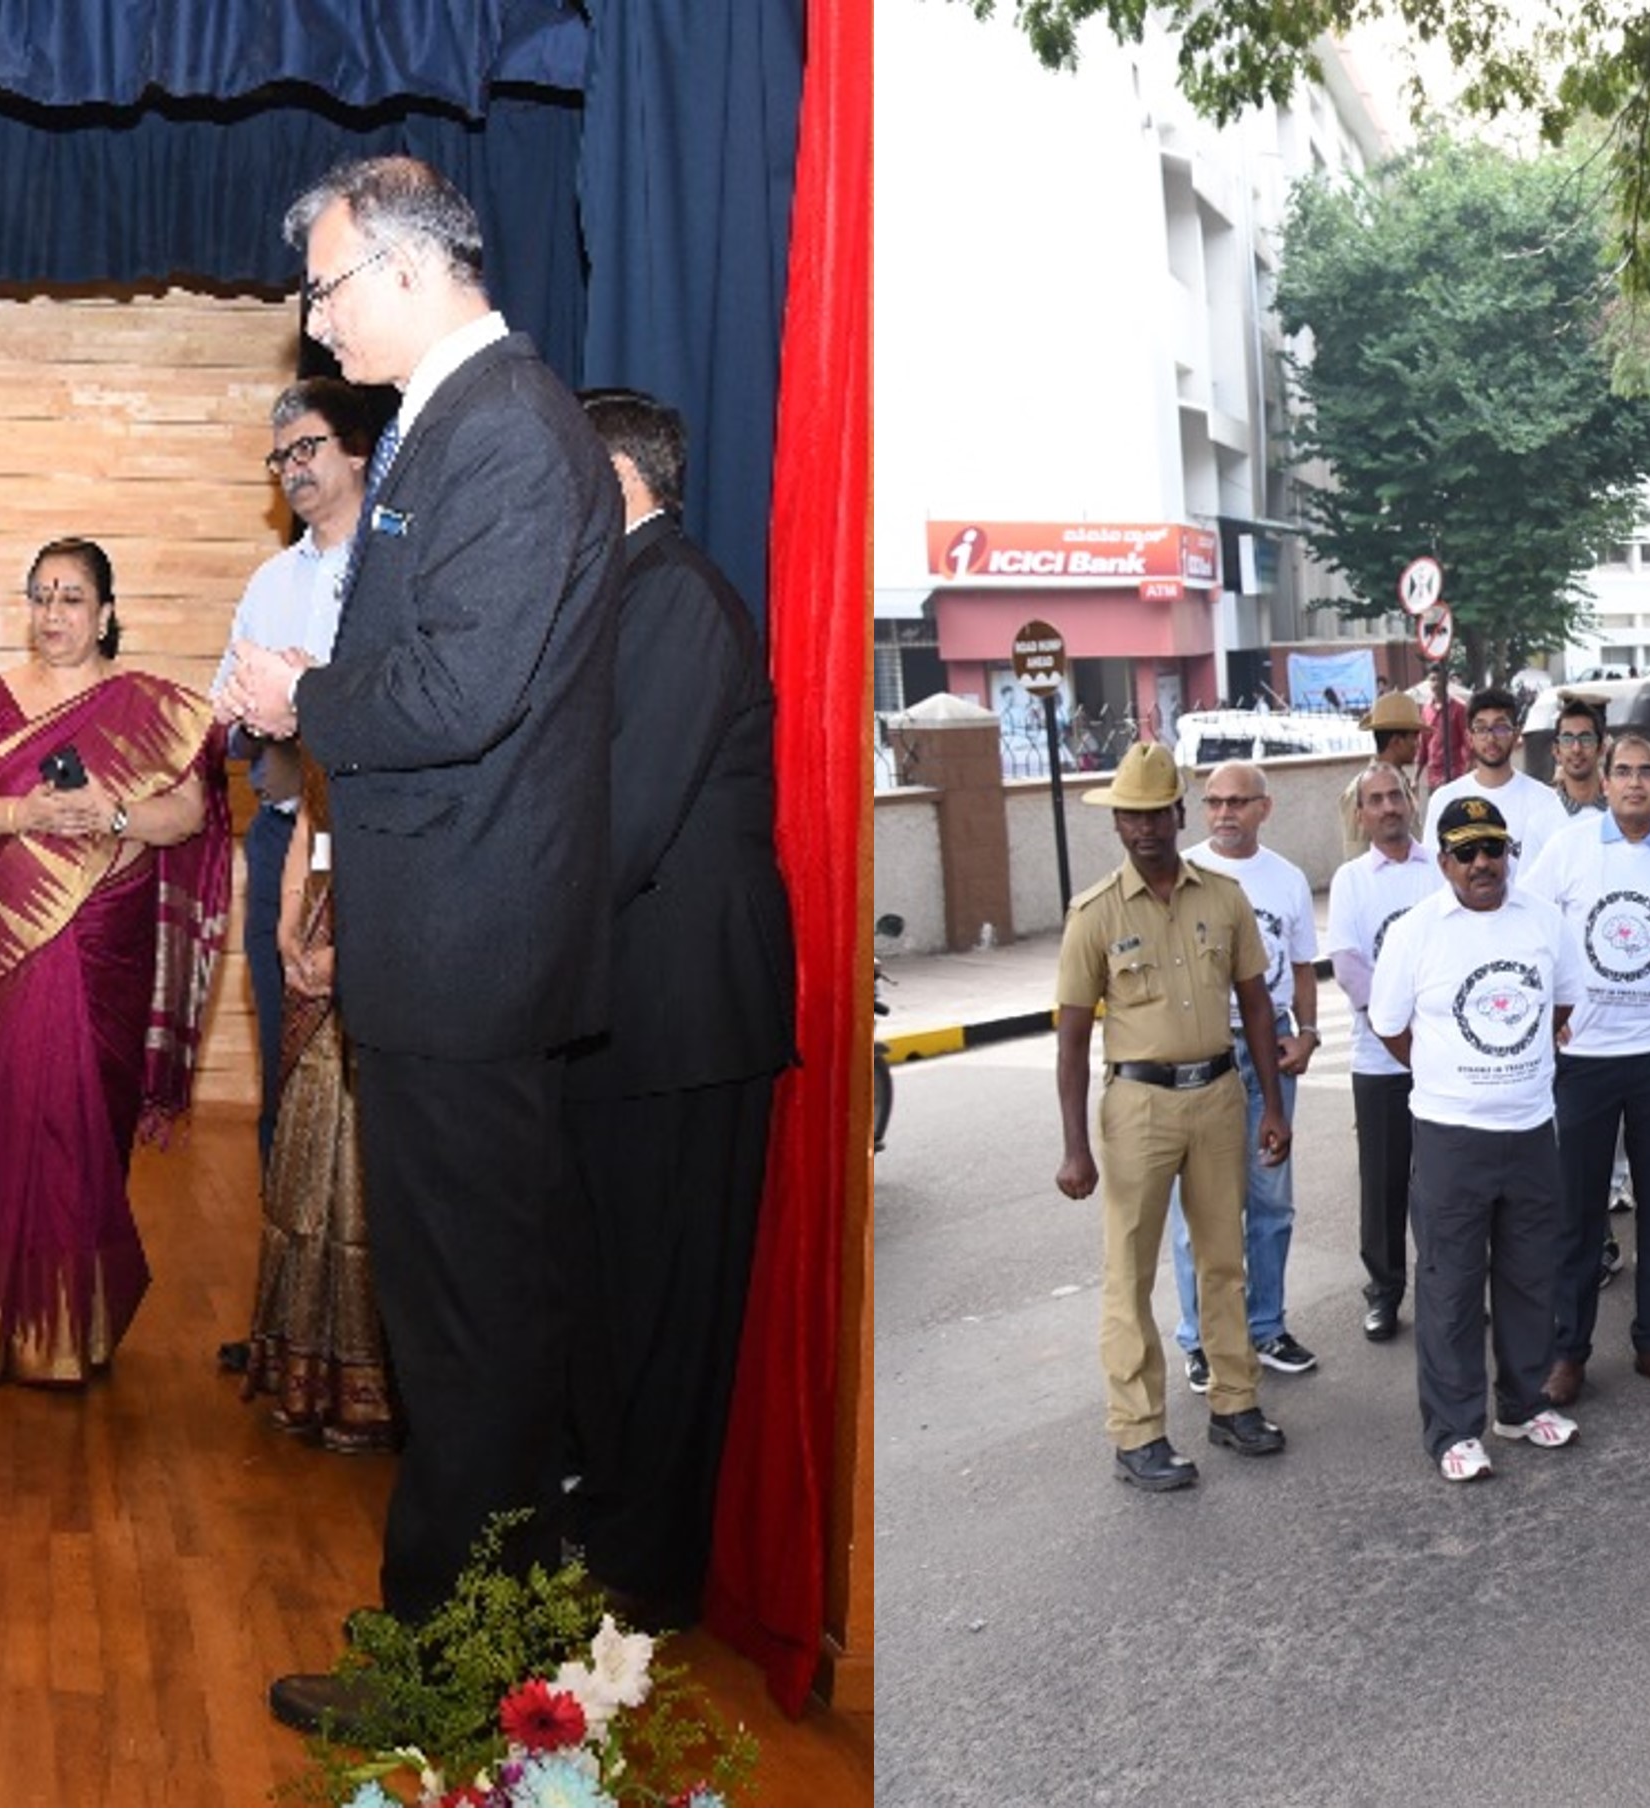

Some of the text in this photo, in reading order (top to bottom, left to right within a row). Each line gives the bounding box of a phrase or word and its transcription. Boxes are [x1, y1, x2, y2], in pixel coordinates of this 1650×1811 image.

[988, 550, 1147, 574] ICICI Bank
[1144, 585, 1178, 598] ATM
